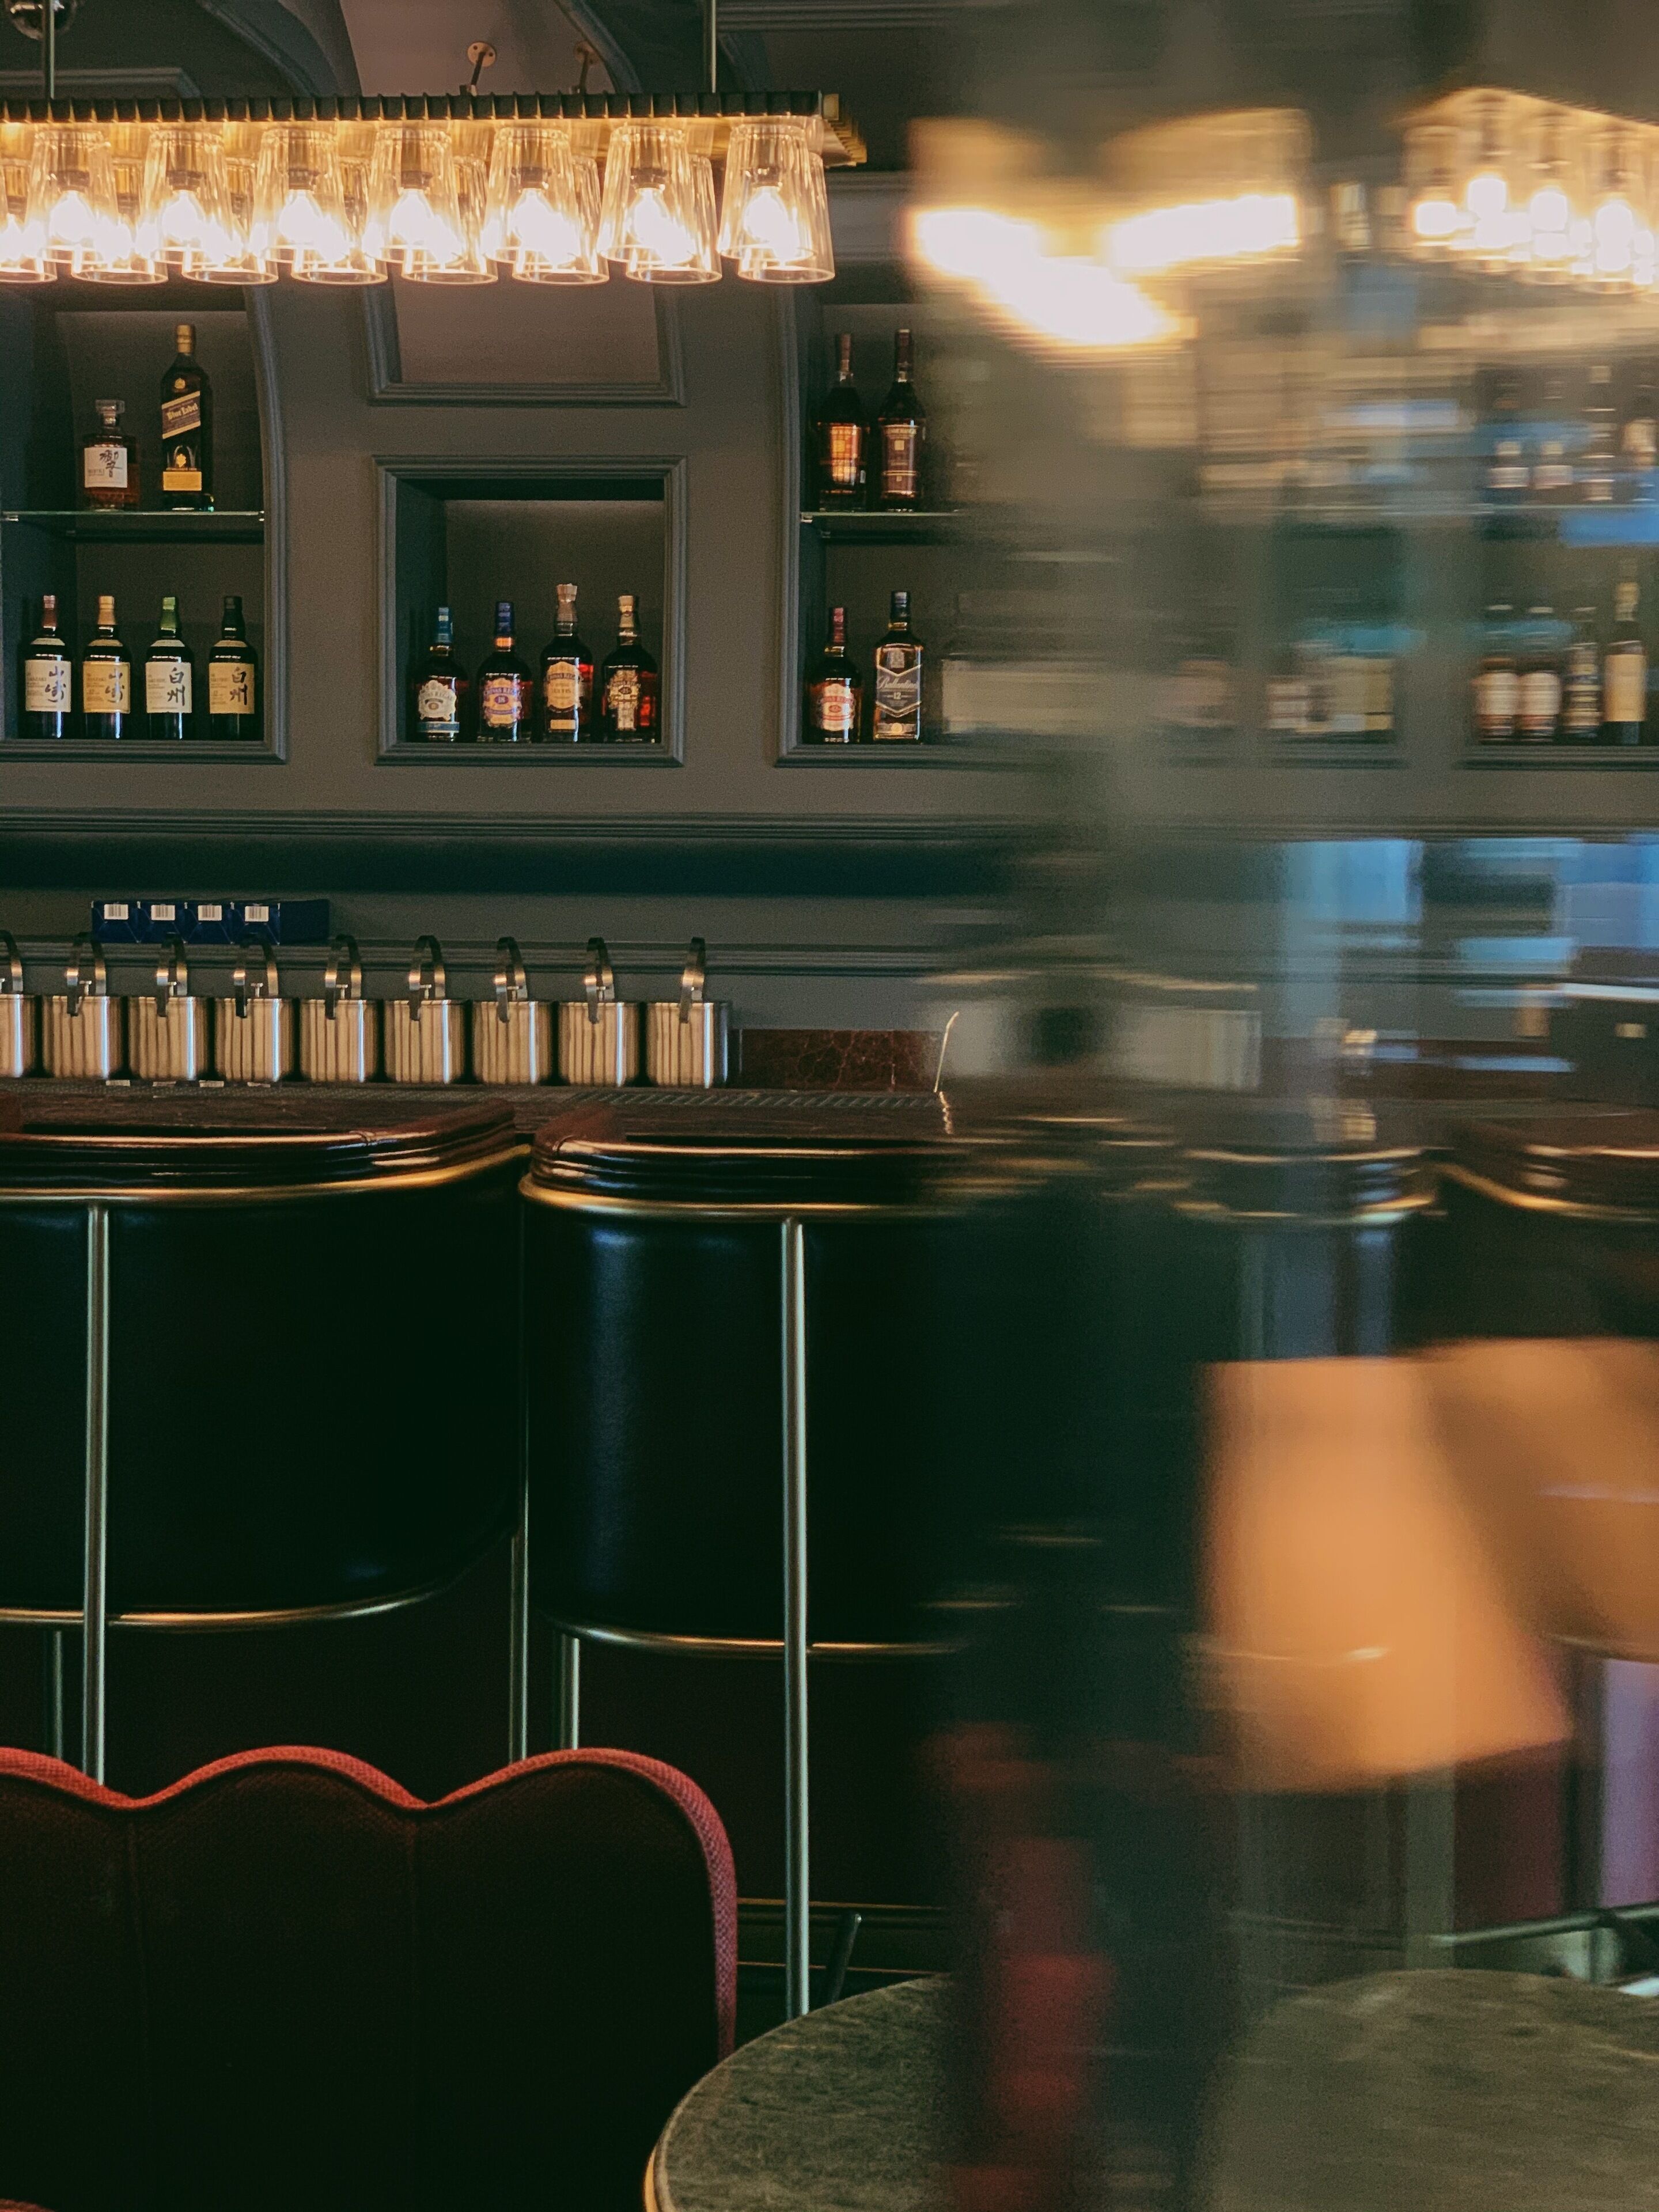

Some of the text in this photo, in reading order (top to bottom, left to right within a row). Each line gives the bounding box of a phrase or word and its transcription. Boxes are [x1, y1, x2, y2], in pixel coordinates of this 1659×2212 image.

[168, 410, 182, 421] Blue
[181, 403, 198, 415] Label
[100, 449, 123, 478] 響
[167, 667, 185, 706] 白州
[230, 666, 248, 706] 白州
